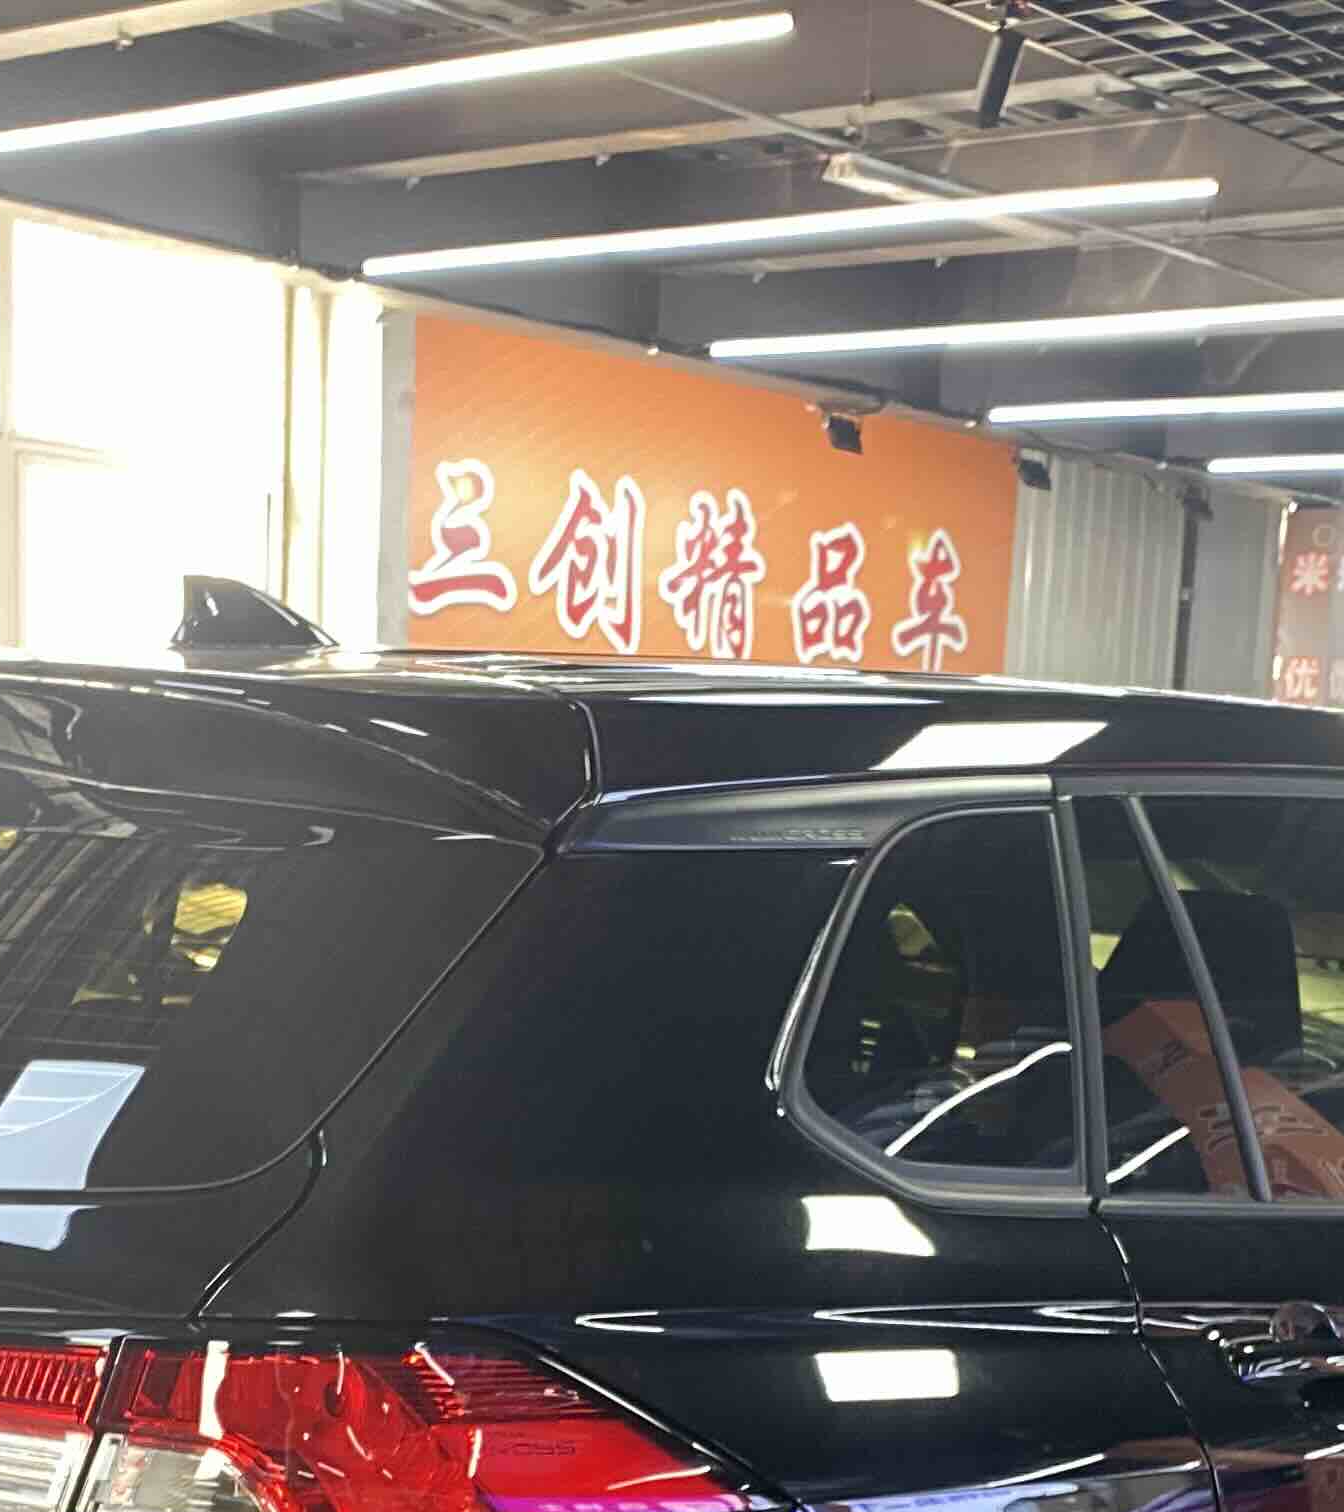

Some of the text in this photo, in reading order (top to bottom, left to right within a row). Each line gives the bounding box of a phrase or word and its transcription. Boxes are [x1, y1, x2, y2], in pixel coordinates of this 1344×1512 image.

[408, 458, 967, 672] 三创精品车
